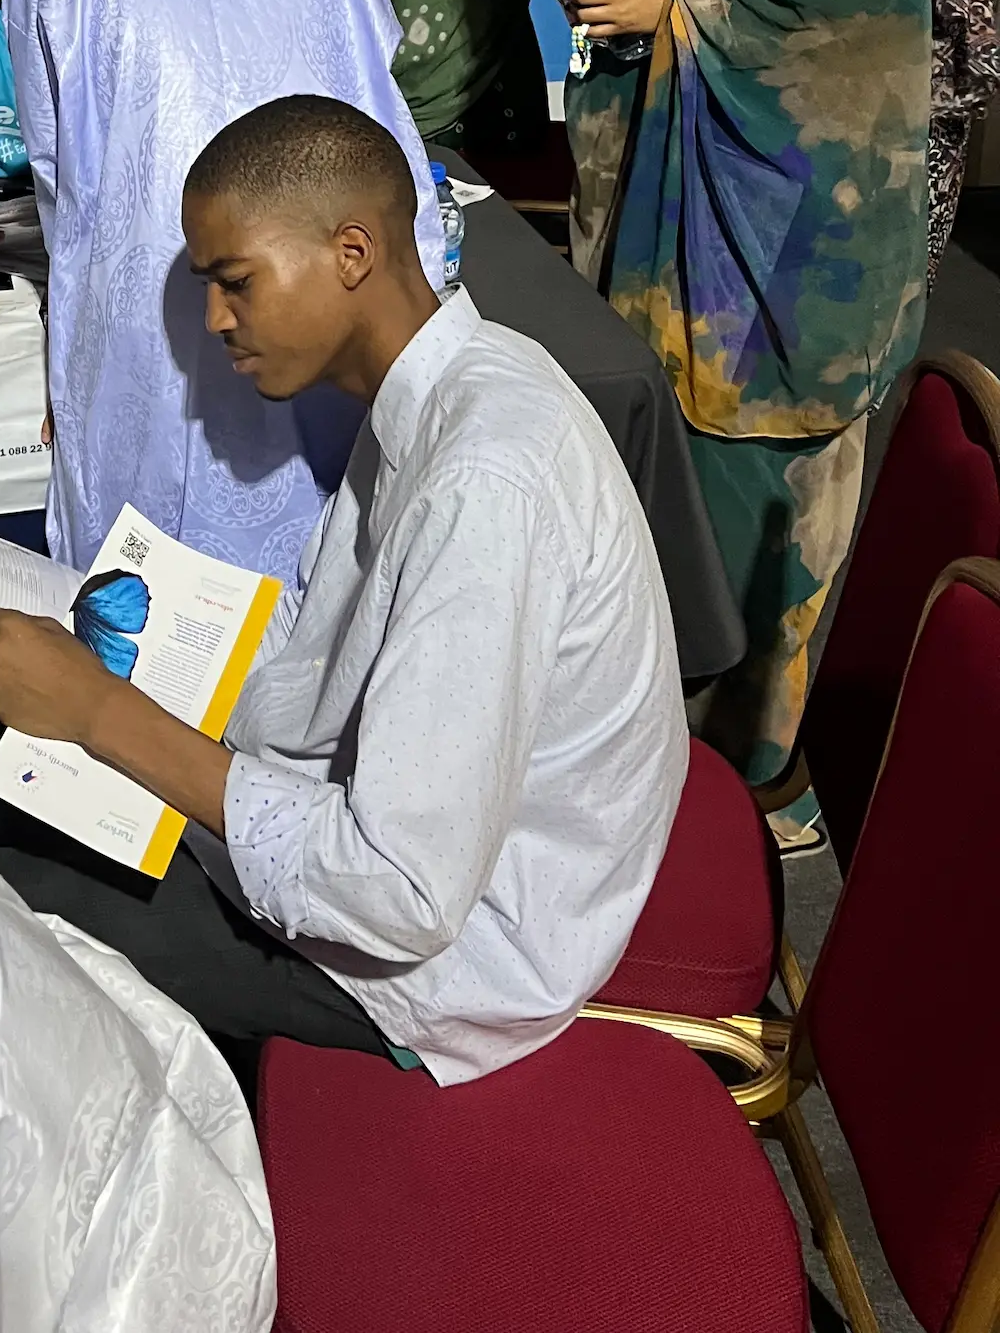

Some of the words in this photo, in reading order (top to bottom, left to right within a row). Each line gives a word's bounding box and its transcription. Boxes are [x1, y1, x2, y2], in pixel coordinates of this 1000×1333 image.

[8, 446, 28, 457] 088
[30, 445, 42, 454] 22
[96, 818, 135, 844] Turkey
